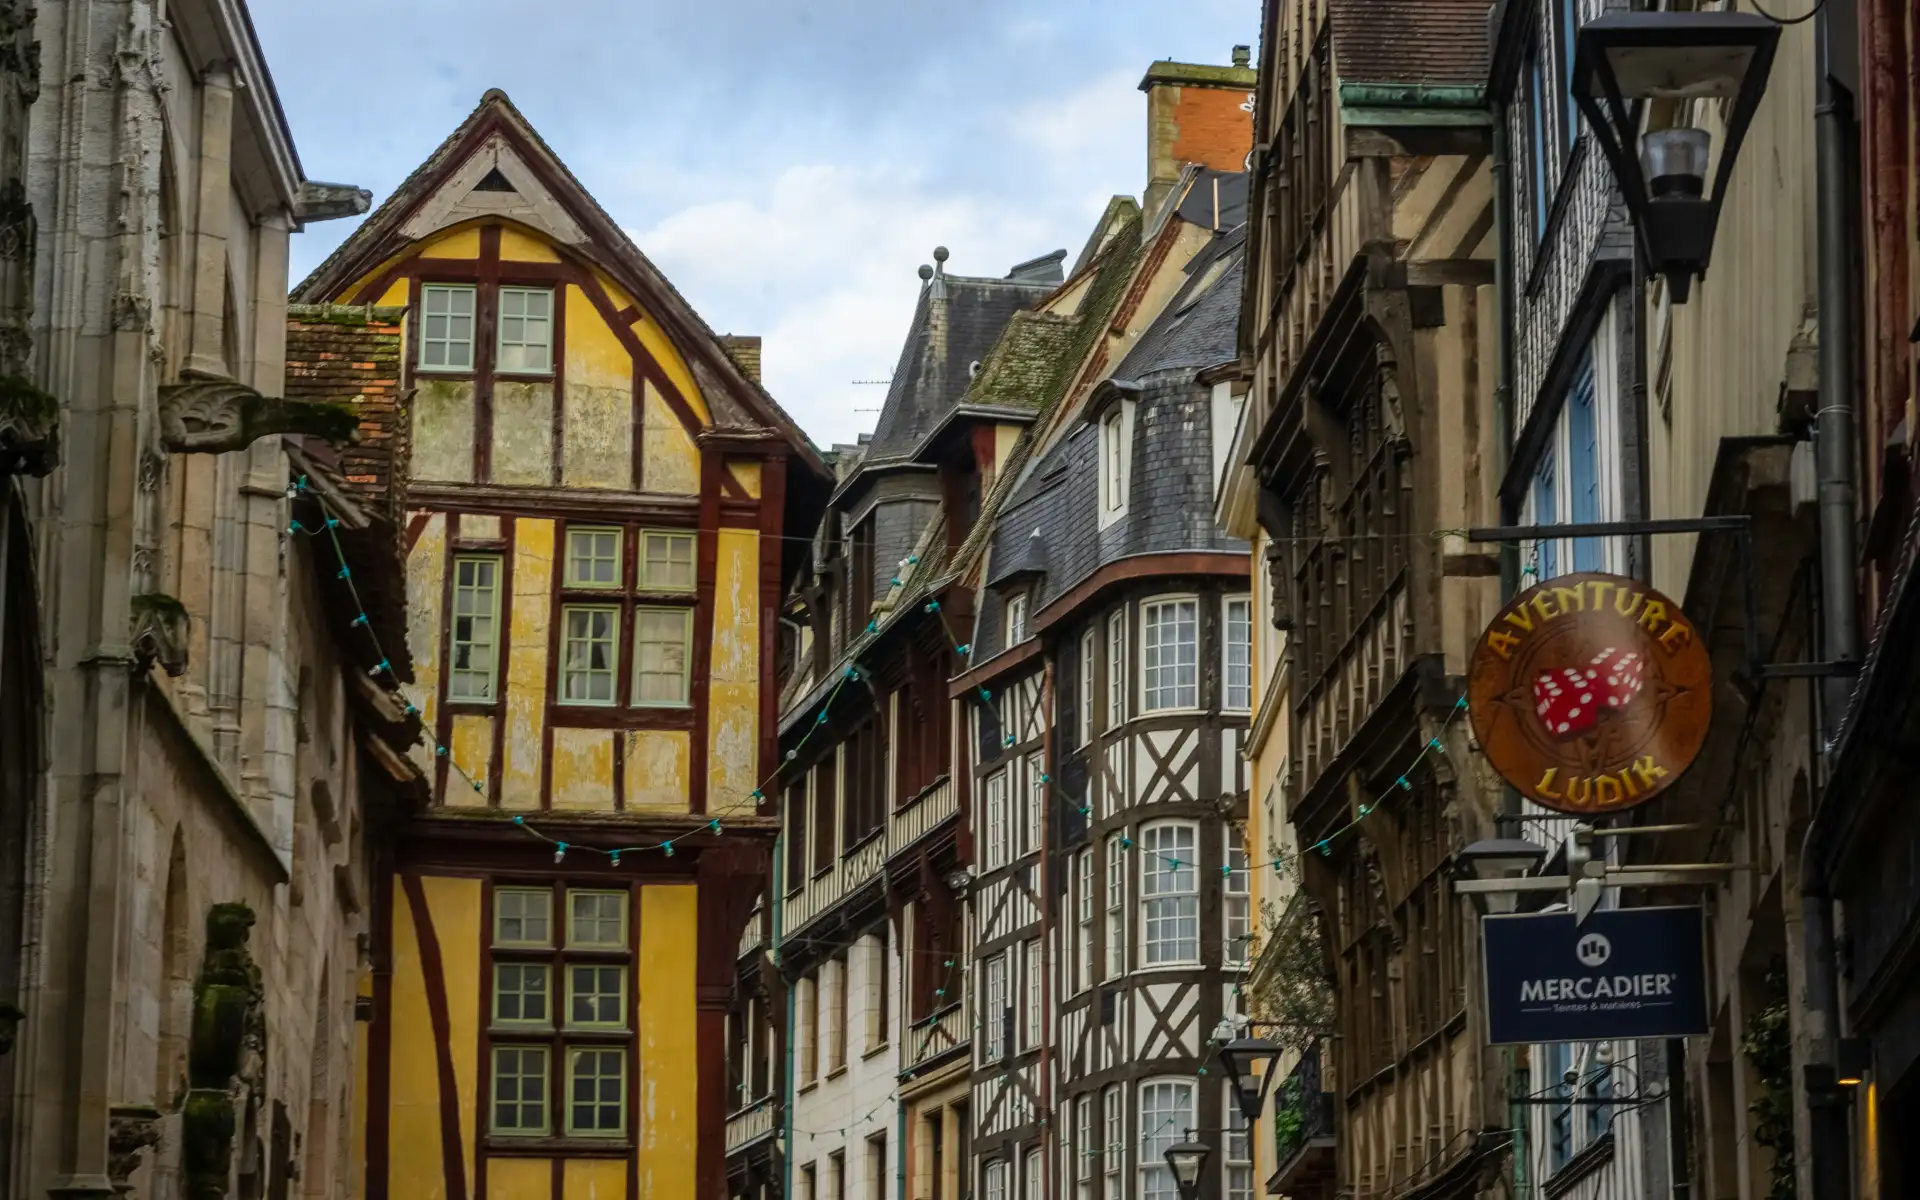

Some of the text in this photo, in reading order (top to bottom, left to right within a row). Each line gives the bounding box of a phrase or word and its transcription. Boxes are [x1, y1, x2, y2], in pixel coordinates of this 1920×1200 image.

[1487, 580, 1692, 660] AVENTURE
[1535, 755, 1669, 807] LUDIK
[1520, 973, 1675, 1002] MERCADIER
